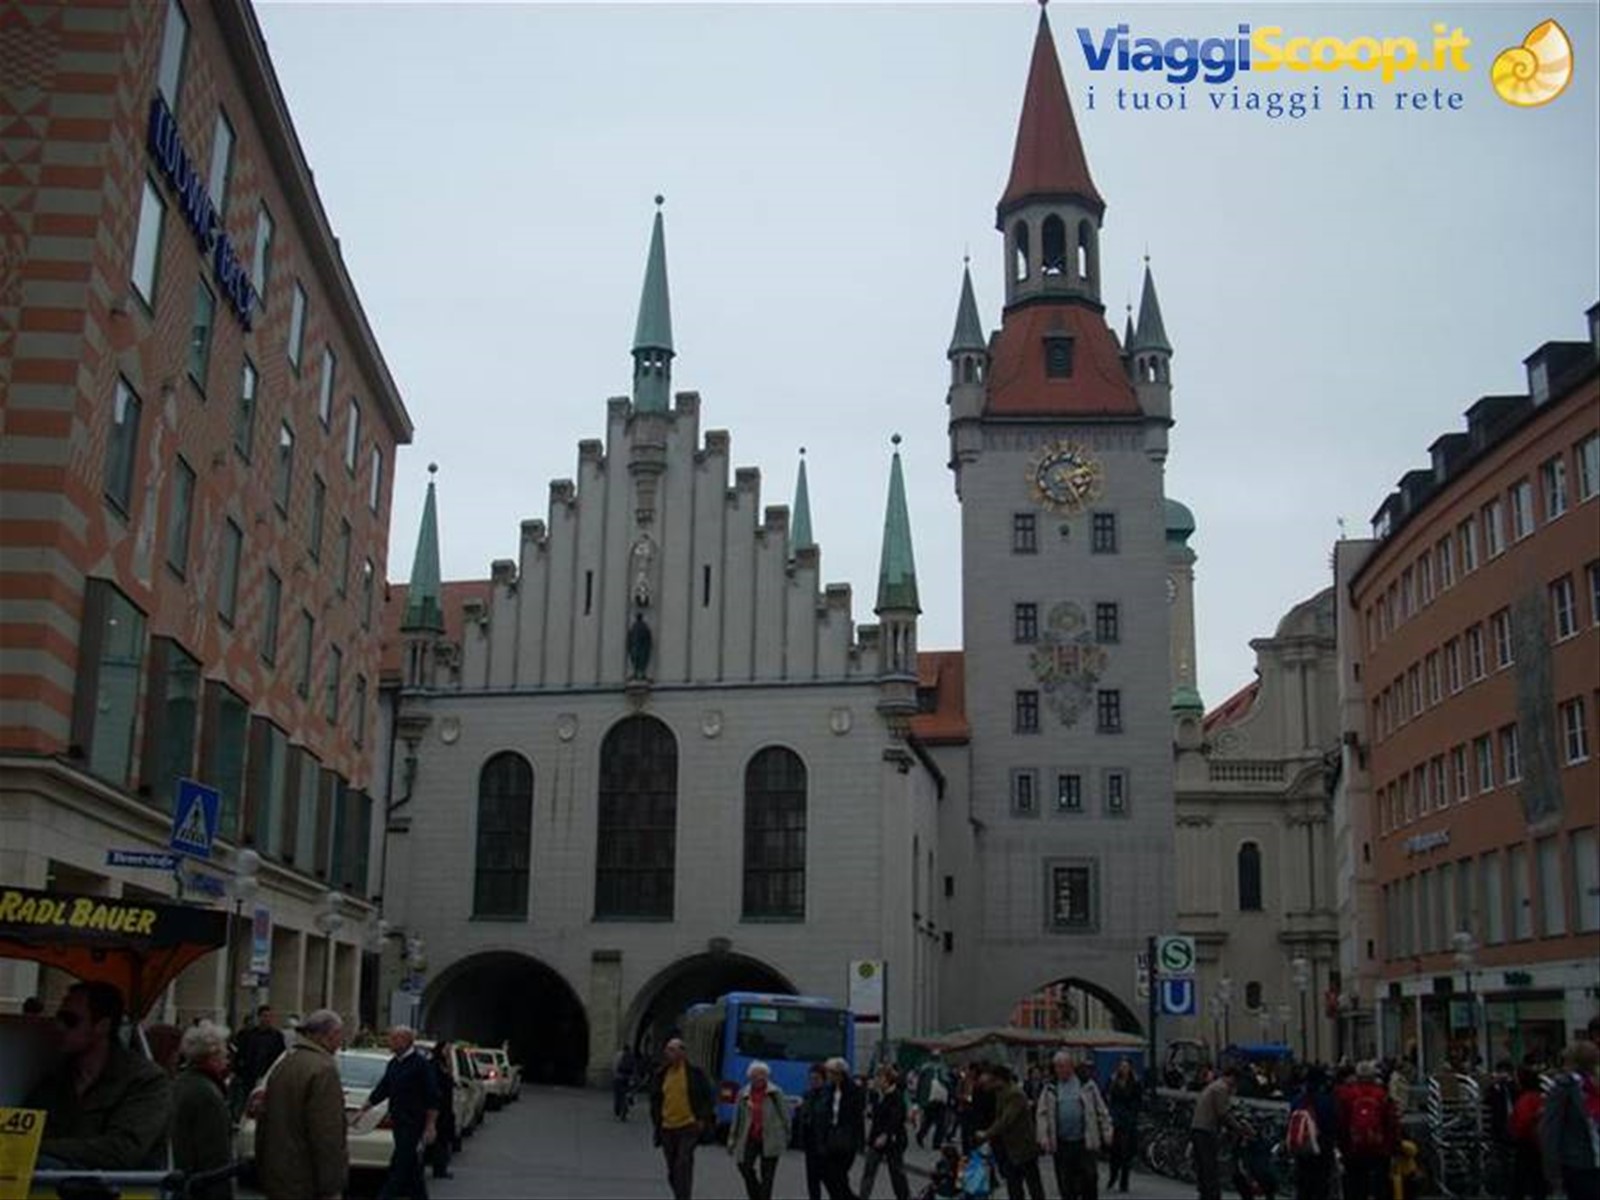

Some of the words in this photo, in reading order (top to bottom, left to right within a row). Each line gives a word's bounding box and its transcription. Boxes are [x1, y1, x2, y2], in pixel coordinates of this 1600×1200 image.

[0, 890, 66, 924] RADL
[69, 897, 156, 934] BAUER
[1163, 939, 1192, 970] S
[1163, 981, 1192, 1014] U
